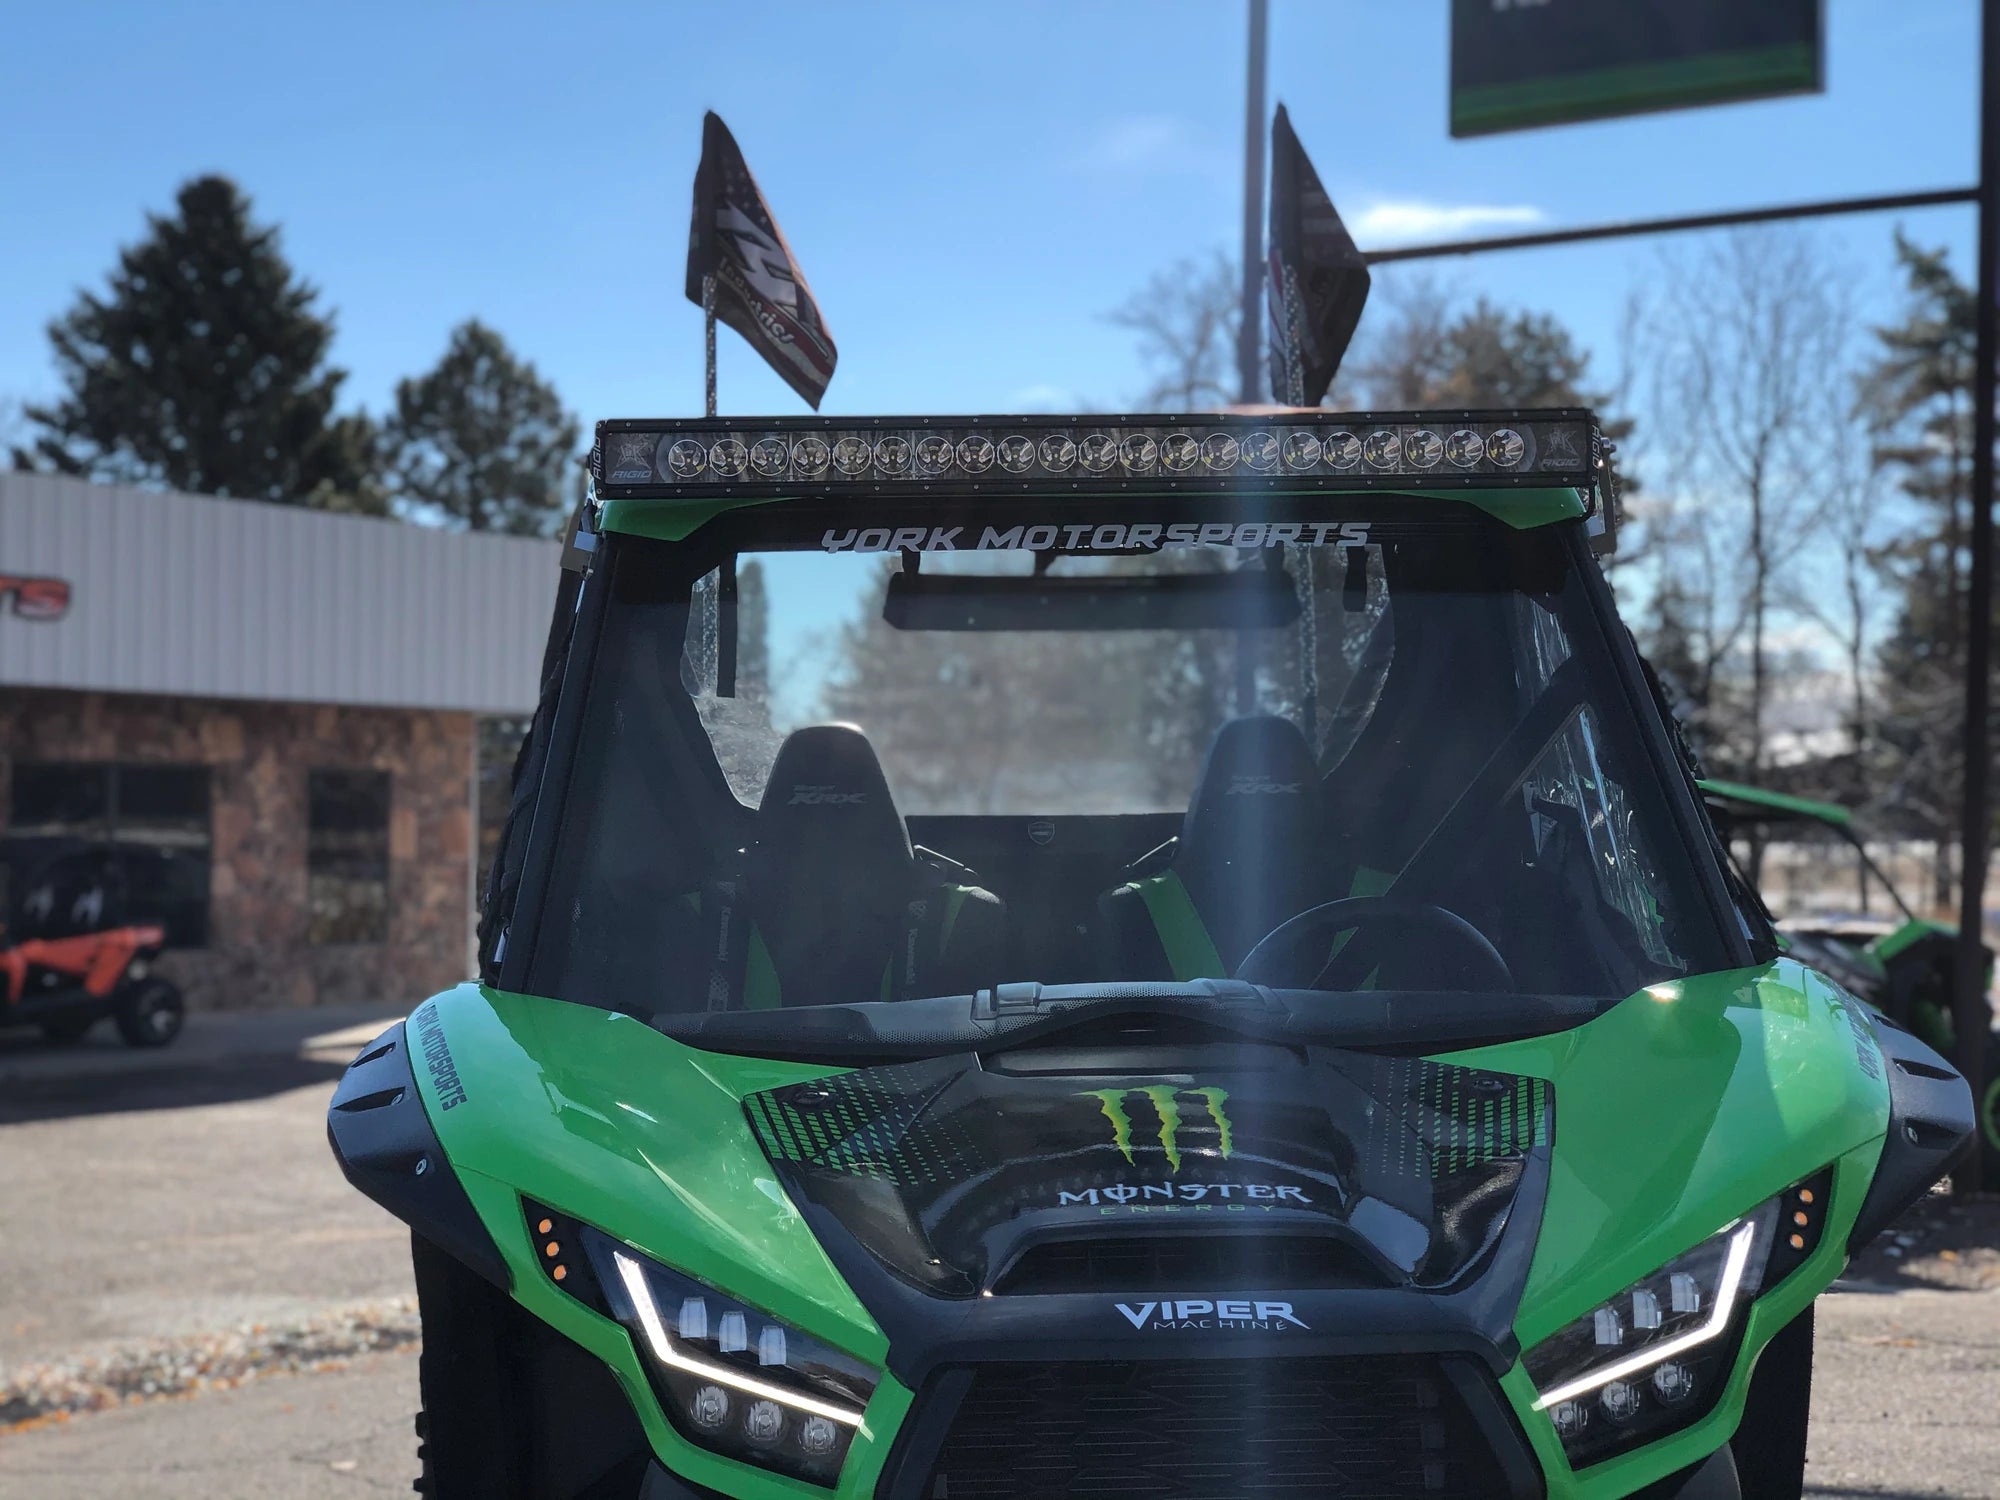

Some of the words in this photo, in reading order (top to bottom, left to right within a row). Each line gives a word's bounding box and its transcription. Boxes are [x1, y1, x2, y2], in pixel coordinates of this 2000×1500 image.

[1541, 458, 1580, 467] RIGID
[611, 470, 653, 479] RIGID
[821, 526, 964, 554] YORK
[976, 521, 1372, 551] MOTORSPORTS
[420, 1023, 469, 1112] MOTORSPORTS
[1057, 1181, 1313, 1206] MONSTER
[1099, 1204, 1275, 1215] ENERGY
[1114, 1300, 1312, 1331] VIPER
[1153, 1319, 1288, 1331] MACHINE
